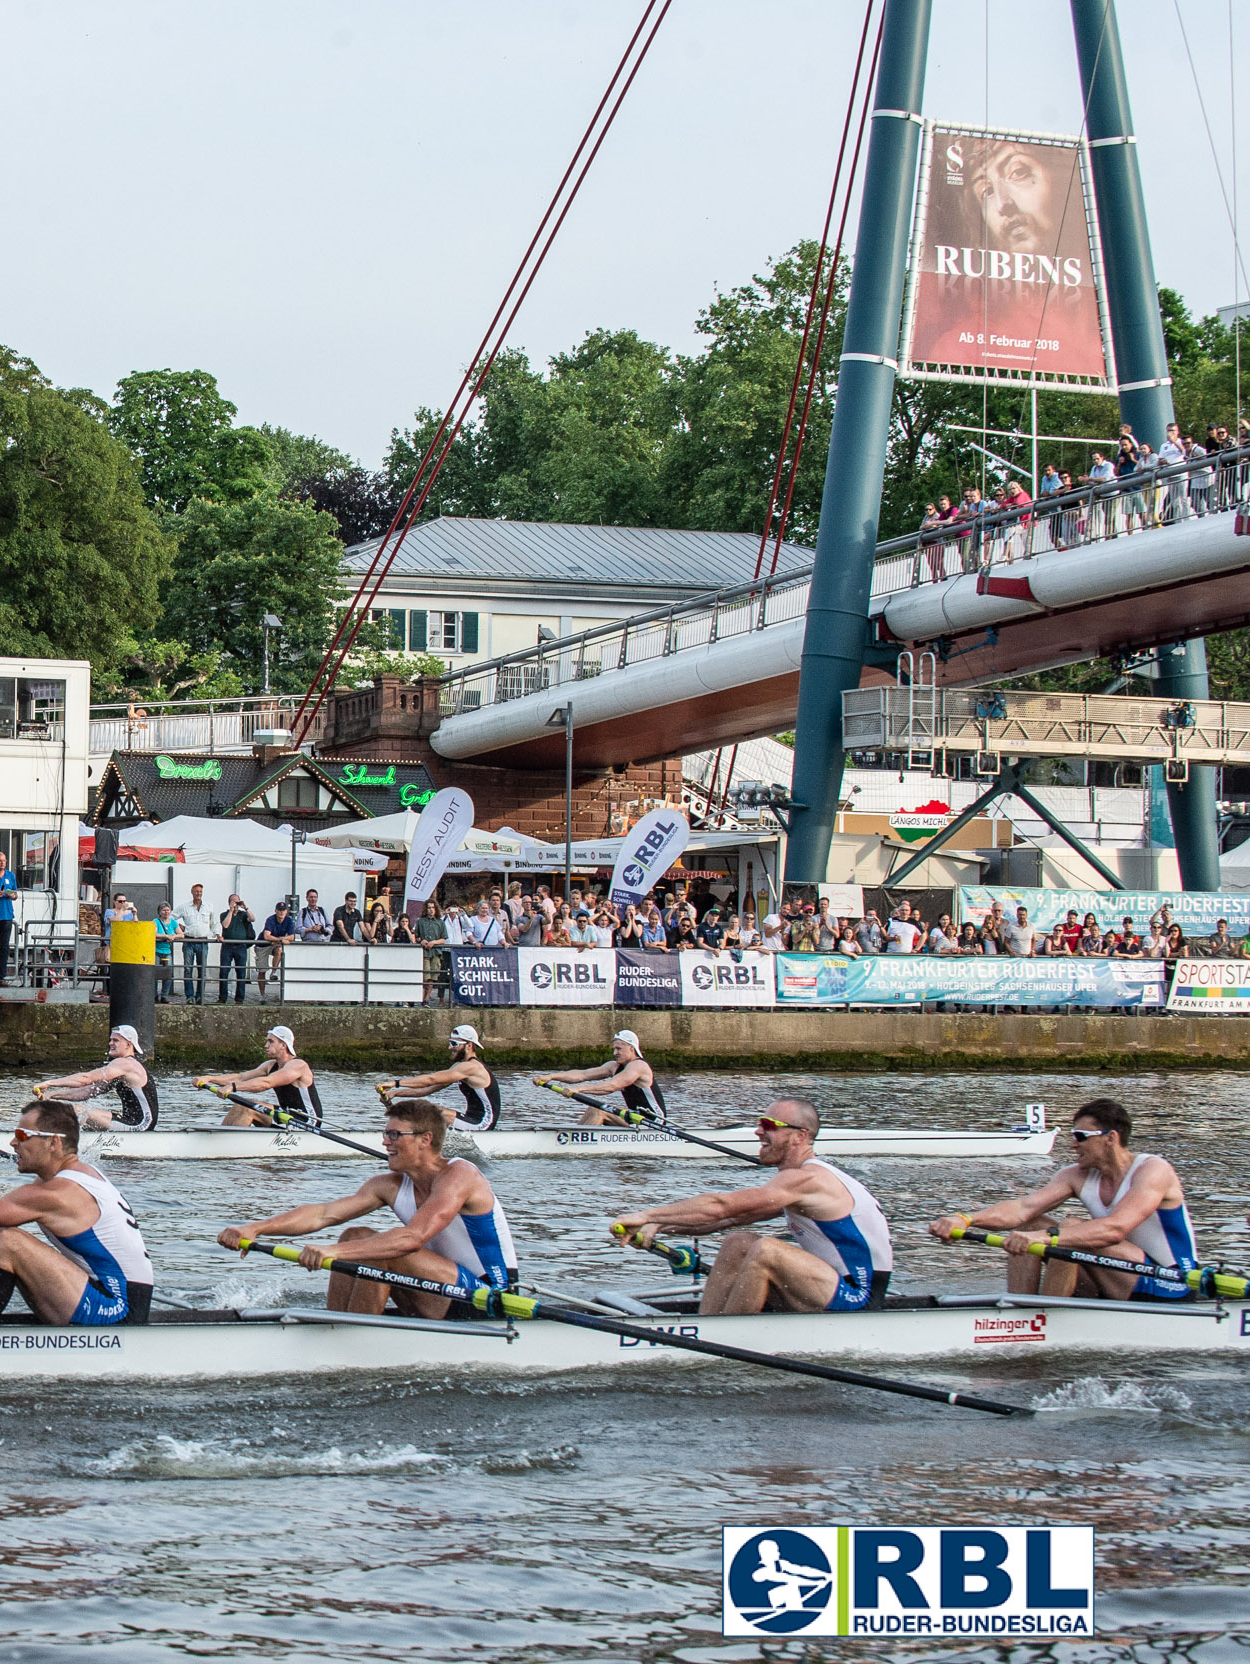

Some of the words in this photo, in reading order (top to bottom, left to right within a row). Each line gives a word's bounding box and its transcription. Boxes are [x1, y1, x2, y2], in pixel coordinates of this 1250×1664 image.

[935, 245, 1082, 287] RUBENS
[959, 331, 974, 344] Ab
[977, 333, 987, 344] 8.
[990, 336, 1032, 349] Februar
[1035, 339, 1059, 351] 2018
[154, 755, 223, 781] Drexel's
[338, 764, 396, 786] Schwenk
[411, 847, 435, 890] BEST
[434, 797, 460, 846] AUDIT
[634, 821, 676, 865] RBL
[1051, 894, 1156, 911] FRANKFURTER
[457, 956, 498, 969] STARK.
[863, 960, 876, 977] 9.
[879, 960, 998, 978] FRANKFURTER
[1002, 963, 1096, 979] RUDERFEST
[458, 970, 514, 983] SCHNELL.
[556, 962, 607, 984] RBL
[619, 966, 655, 976] RUDER-
[717, 964, 766, 985] RBL
[458, 984, 486, 997] GUT.
[618, 977, 678, 988] BUNDESLIGA
[937, 982, 995, 991] HOLBEINSTEG
[1075, 983, 1097, 992] UFER
[944, 993, 1019, 1001] WWW.RUDERFEST.DE
[1172, 999, 1225, 1008] FRANKFURT
[1031, 1105, 1040, 1124] 5
[269, 1132, 298, 1148] Melitta
[571, 1132, 598, 1142] RBL
[1071, 1251, 1097, 1264] STARK.
[1098, 1257, 1135, 1271] SCHNELL.
[1135, 1264, 1154, 1275] GUT.
[357, 1265, 384, 1280] STARK.
[384, 1272, 421, 1288] SCHNELL.
[421, 1280, 441, 1292] GUT.
[1159, 1267, 1180, 1279] RBL
[446, 1285, 467, 1297] RBL
[974, 1318, 1029, 1333] hilzinger
